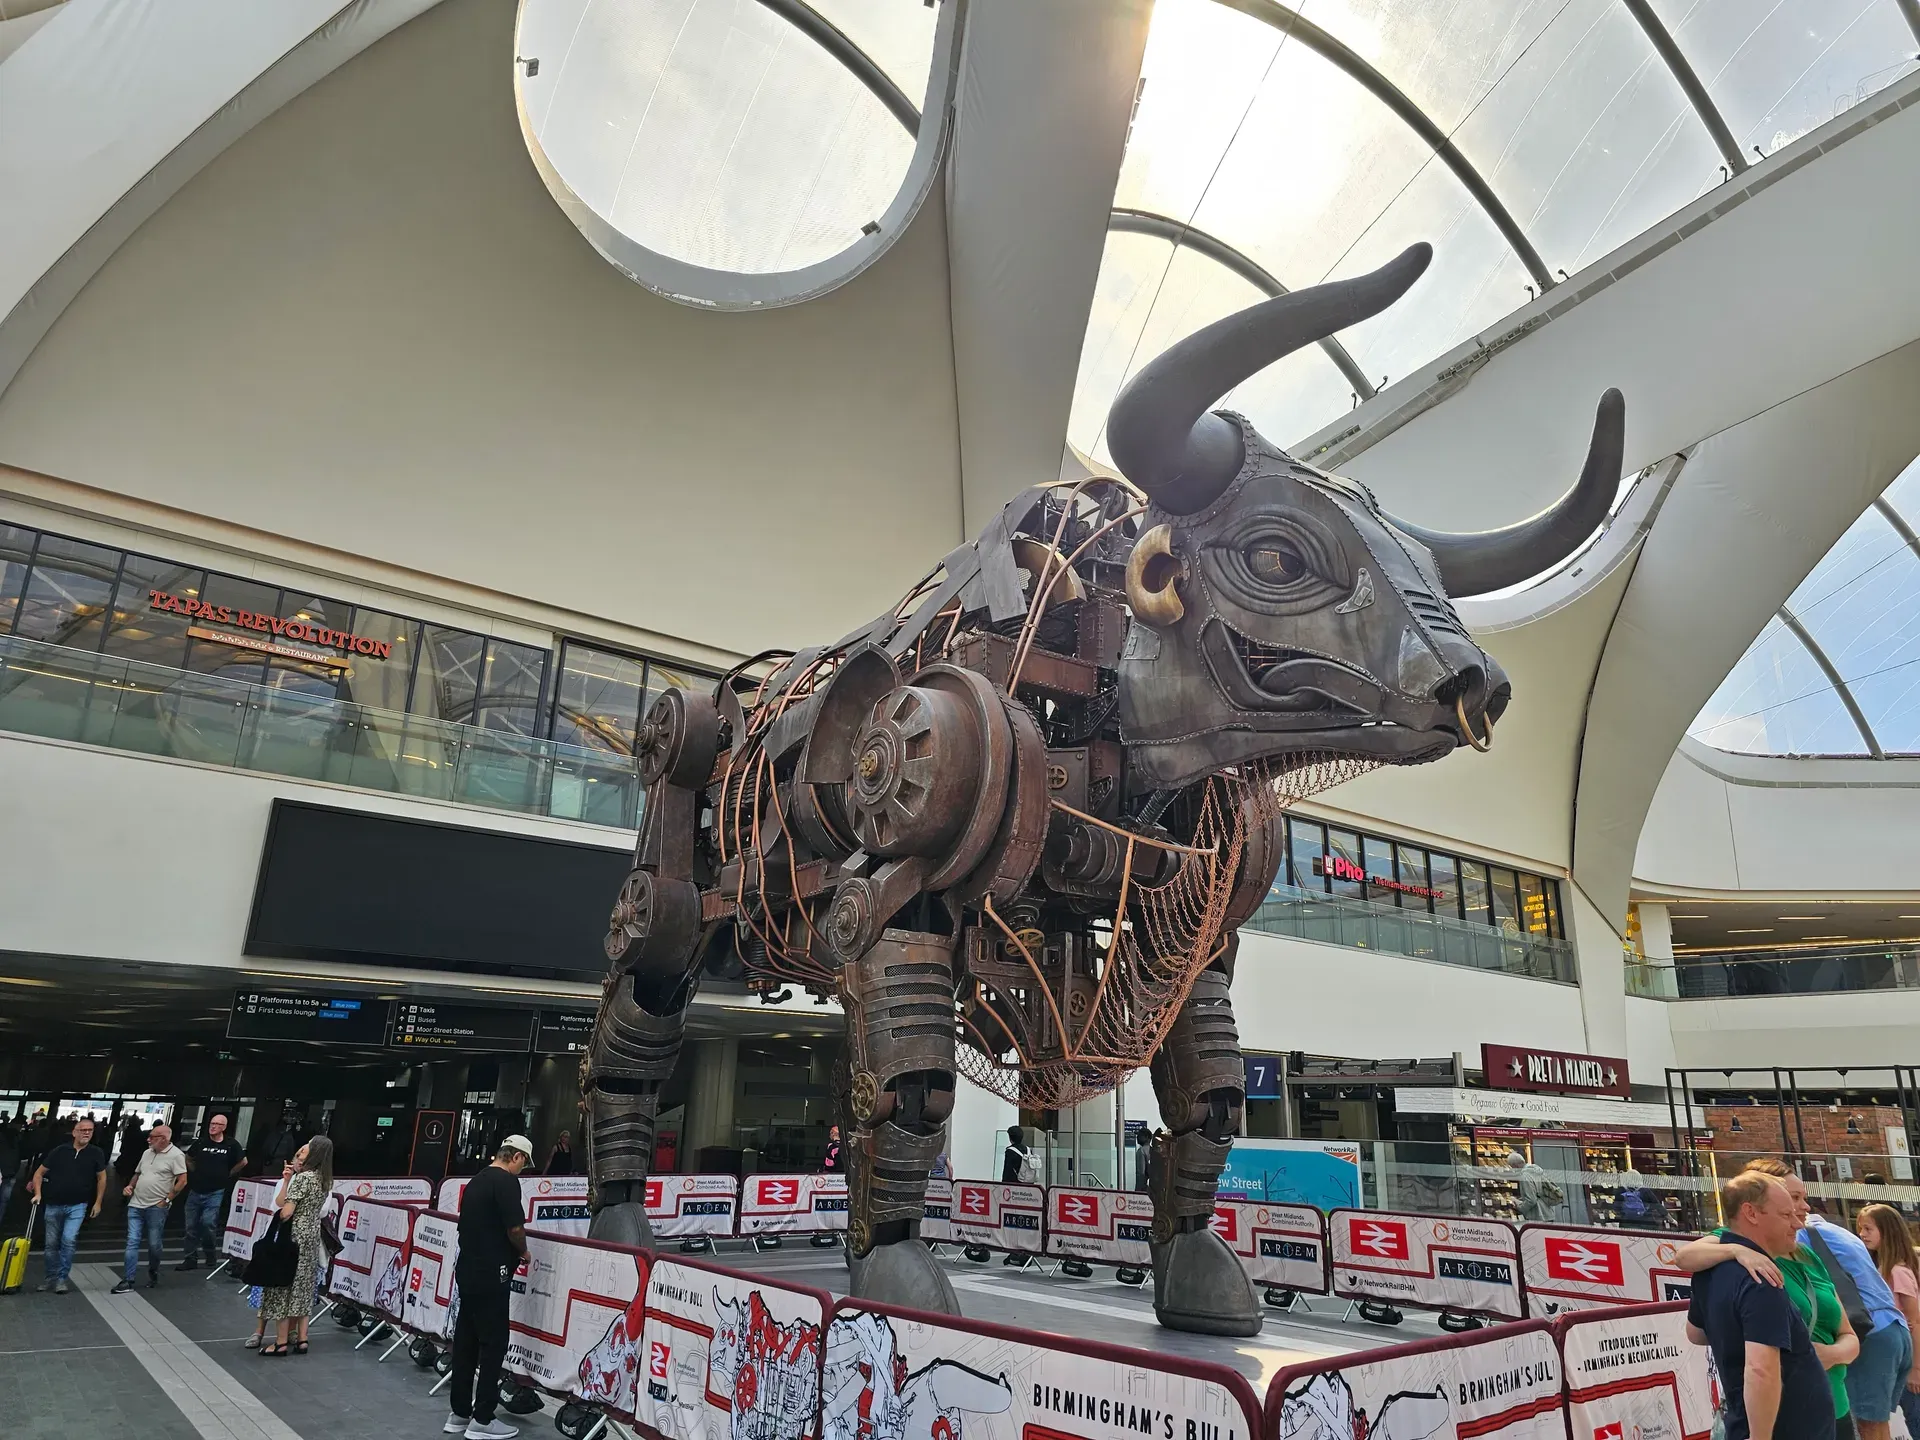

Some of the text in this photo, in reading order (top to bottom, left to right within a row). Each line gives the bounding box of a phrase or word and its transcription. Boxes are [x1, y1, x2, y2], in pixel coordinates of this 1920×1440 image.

[150, 590, 392, 658] TAPAS REVOLUTION
[276, 646, 329, 662] RESTAURANT
[1335, 857, 1364, 880] Pho
[1374, 876, 1445, 899] Vietnamese street food
[260, 996, 294, 1005] Platforms
[258, 1006, 274, 1014] First
[275, 1007, 293, 1015] class
[293, 1008, 316, 1017] lounge
[419, 1006, 435, 1014] Taxis
[418, 1016, 436, 1024] Buses
[560, 1015, 586, 1023] Platforms
[415, 1036, 428, 1044] Way
[1254, 1066, 1265, 1087] 7
[1527, 1054, 1605, 1088] PRET A MANGER
[1470, 1094, 1560, 1114] Organic Coffee Good Food
[1217, 1176, 1263, 1190] ew Street
[817, 1200, 848, 1208] ARTE
[924, 1207, 949, 1217] RTEM
[1271, 1218, 1315, 1229] Combined Authority
[1120, 1227, 1154, 1237] ARTE
[1451, 1227, 1494, 1237] West Midlands
[1451, 1234, 1508, 1246] Combined Authority
[1358, 1278, 1416, 1292] @NetworkRailBHM
[1033, 1383, 1174, 1440] BIRMINGHAM'S
